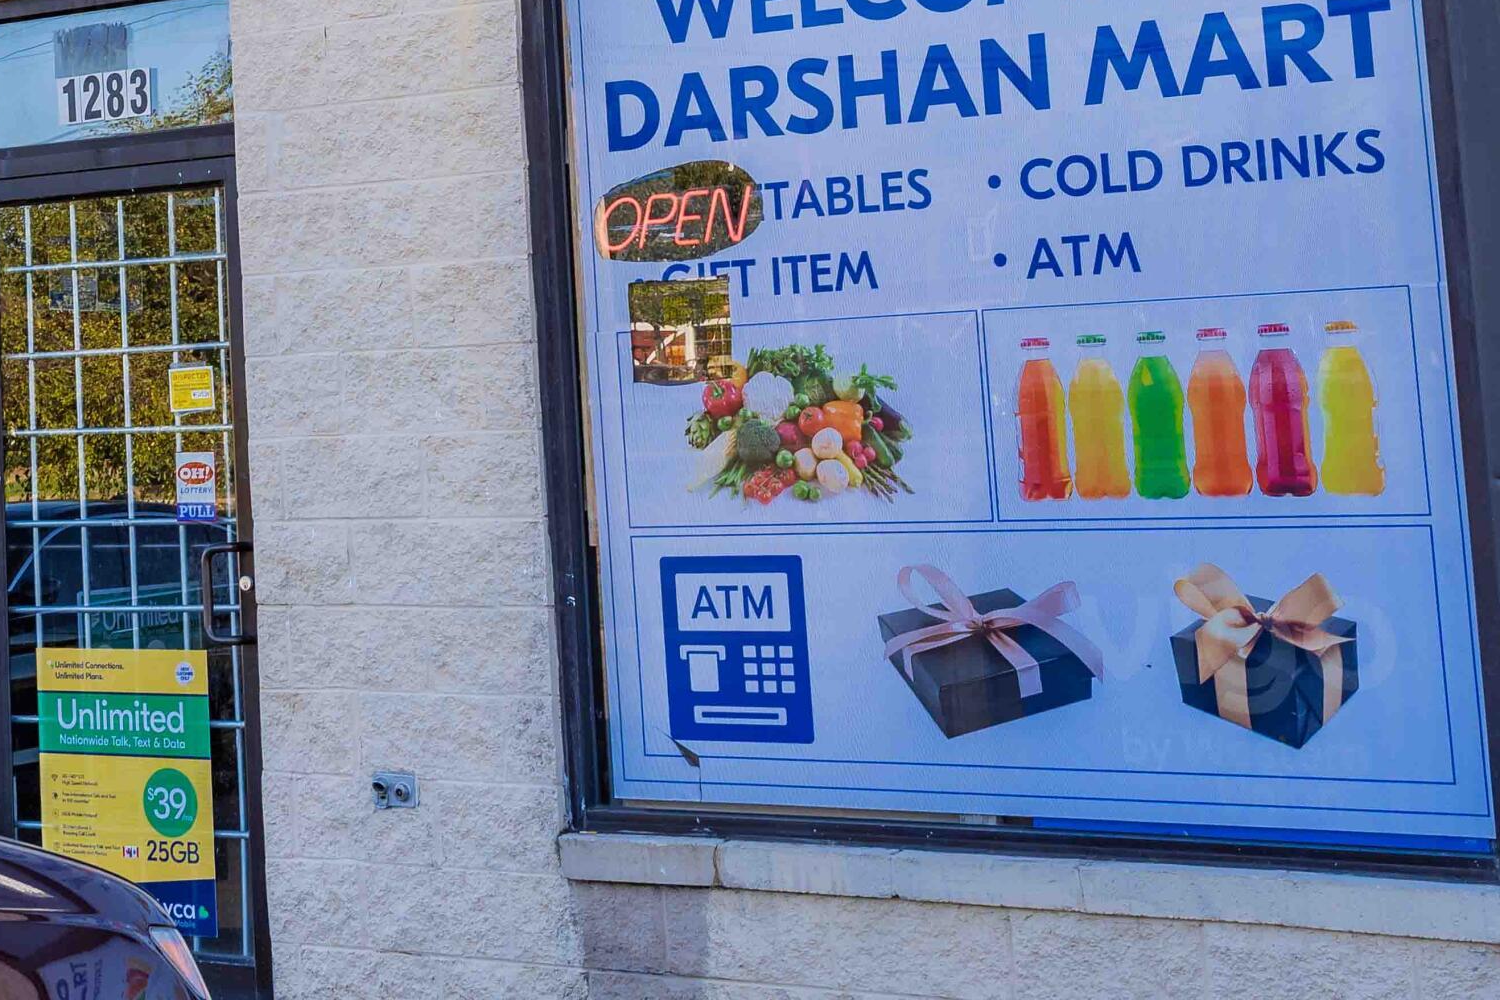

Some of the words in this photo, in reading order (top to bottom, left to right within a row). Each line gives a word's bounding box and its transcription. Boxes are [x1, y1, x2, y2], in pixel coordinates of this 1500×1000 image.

[63, 69, 148, 123] 1283
[604, 32, 1052, 153] DARSHAN
[1019, 149, 1164, 200] COLD
[1183, 129, 1386, 187] DRINKS
[756, 168, 932, 222] TABLES
[603, 185, 753, 252] OPEN
[772, 251, 879, 296] ITEM
[1026, 231, 1142, 280] ATM
[179, 504, 214, 518] PULL
[180, 486, 212, 495] LOTTERY
[691, 584, 775, 620] ATM
[57, 698, 185, 734] Unlimited
[60, 733, 109, 747] Nationwide
[111, 735, 131, 748] Talk,
[133, 737, 150, 748] Text
[153, 739, 161, 749] &
[163, 738, 185, 750] Data
[158, 899, 196, 920] yca
